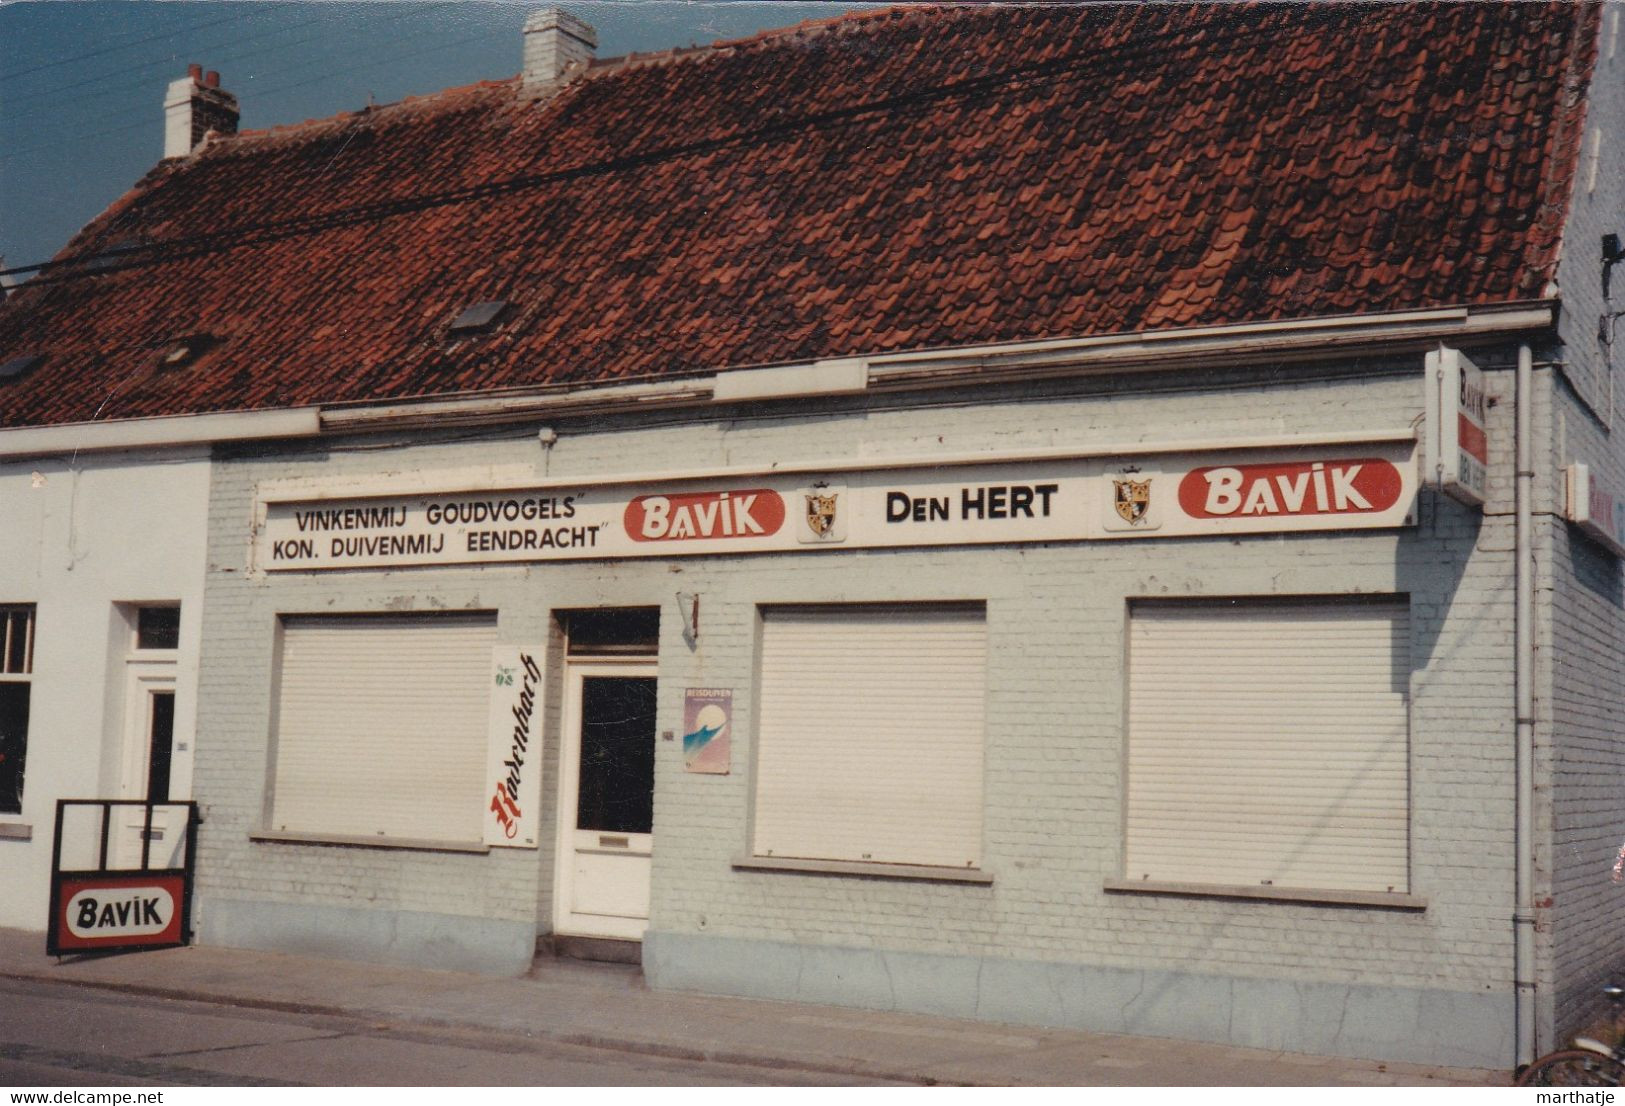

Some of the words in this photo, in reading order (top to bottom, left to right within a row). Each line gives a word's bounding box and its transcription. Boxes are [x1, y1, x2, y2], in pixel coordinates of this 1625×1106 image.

[962, 484, 1059, 519] HERT
[1202, 461, 1375, 516] BAVIK
[296, 506, 407, 531] VINKENMIJ
[641, 491, 765, 539] BAVIK
[273, 540, 319, 560] KON.
[331, 533, 444, 558] DUIVENMIJ
[490, 652, 542, 839] Rodenbach
[76, 896, 164, 929] BAVIK
